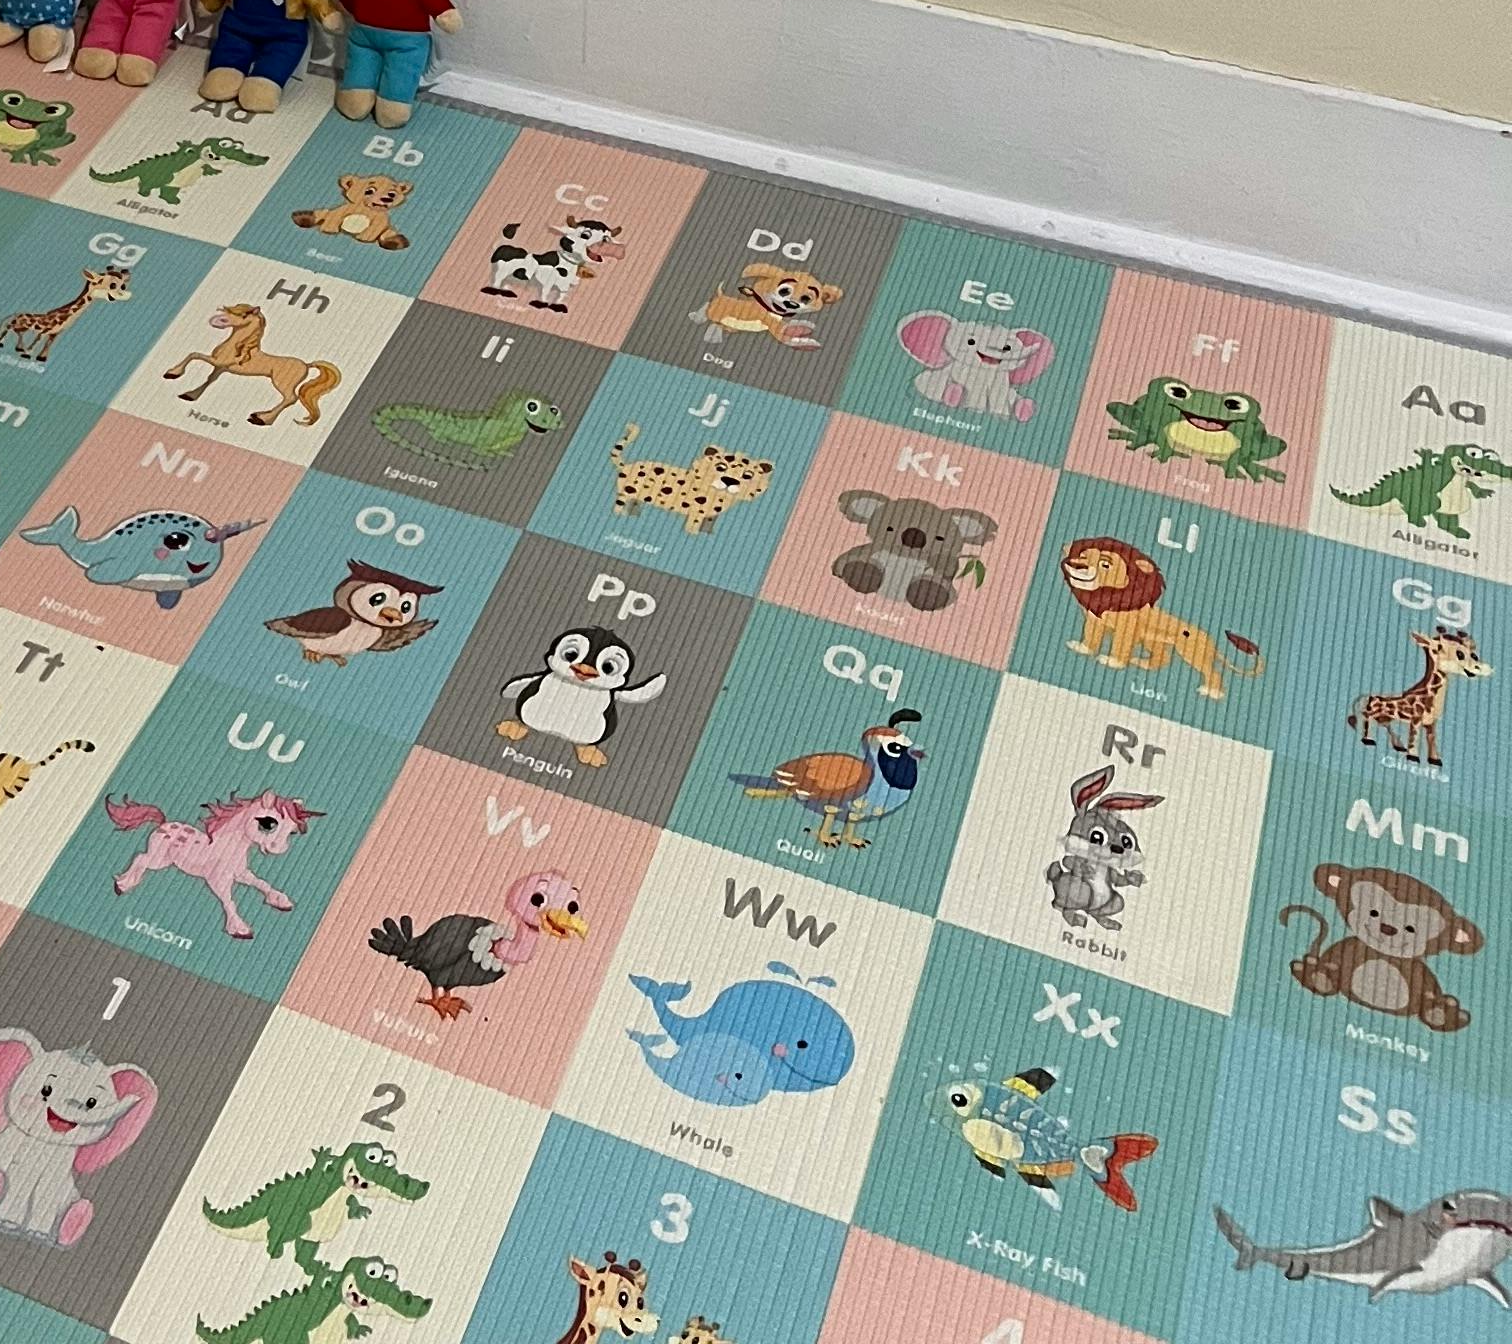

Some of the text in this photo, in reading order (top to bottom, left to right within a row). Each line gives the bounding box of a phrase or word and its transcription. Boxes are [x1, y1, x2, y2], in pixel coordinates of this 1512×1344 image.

[361, 134, 426, 168] Bb
[87, 231, 149, 269] Gg
[746, 228, 814, 262] Dd
[265, 277, 332, 314] Hh
[959, 279, 1016, 312] Ee
[702, 351, 735, 370] Dog
[187, 408, 231, 430] Horse
[1401, 385, 1487, 425] Aa
[895, 446, 964, 488] Kk
[354, 505, 426, 546] Oo
[588, 571, 657, 620] Pp
[1130, 680, 1169, 703] Lion
[226, 712, 305, 764] Uu
[500, 745, 575, 780] Penguin
[722, 874, 838, 948] Ww
[121, 913, 195, 952] Unicorn
[1060, 929, 1129, 963] Rabbit
[102, 976, 132, 1022] 1
[1344, 1022, 1432, 1063] Monkey
[359, 1083, 408, 1133] 2
[667, 1119, 735, 1159] Whale
[965, 1229, 1088, 1287] X-Ray Fish
